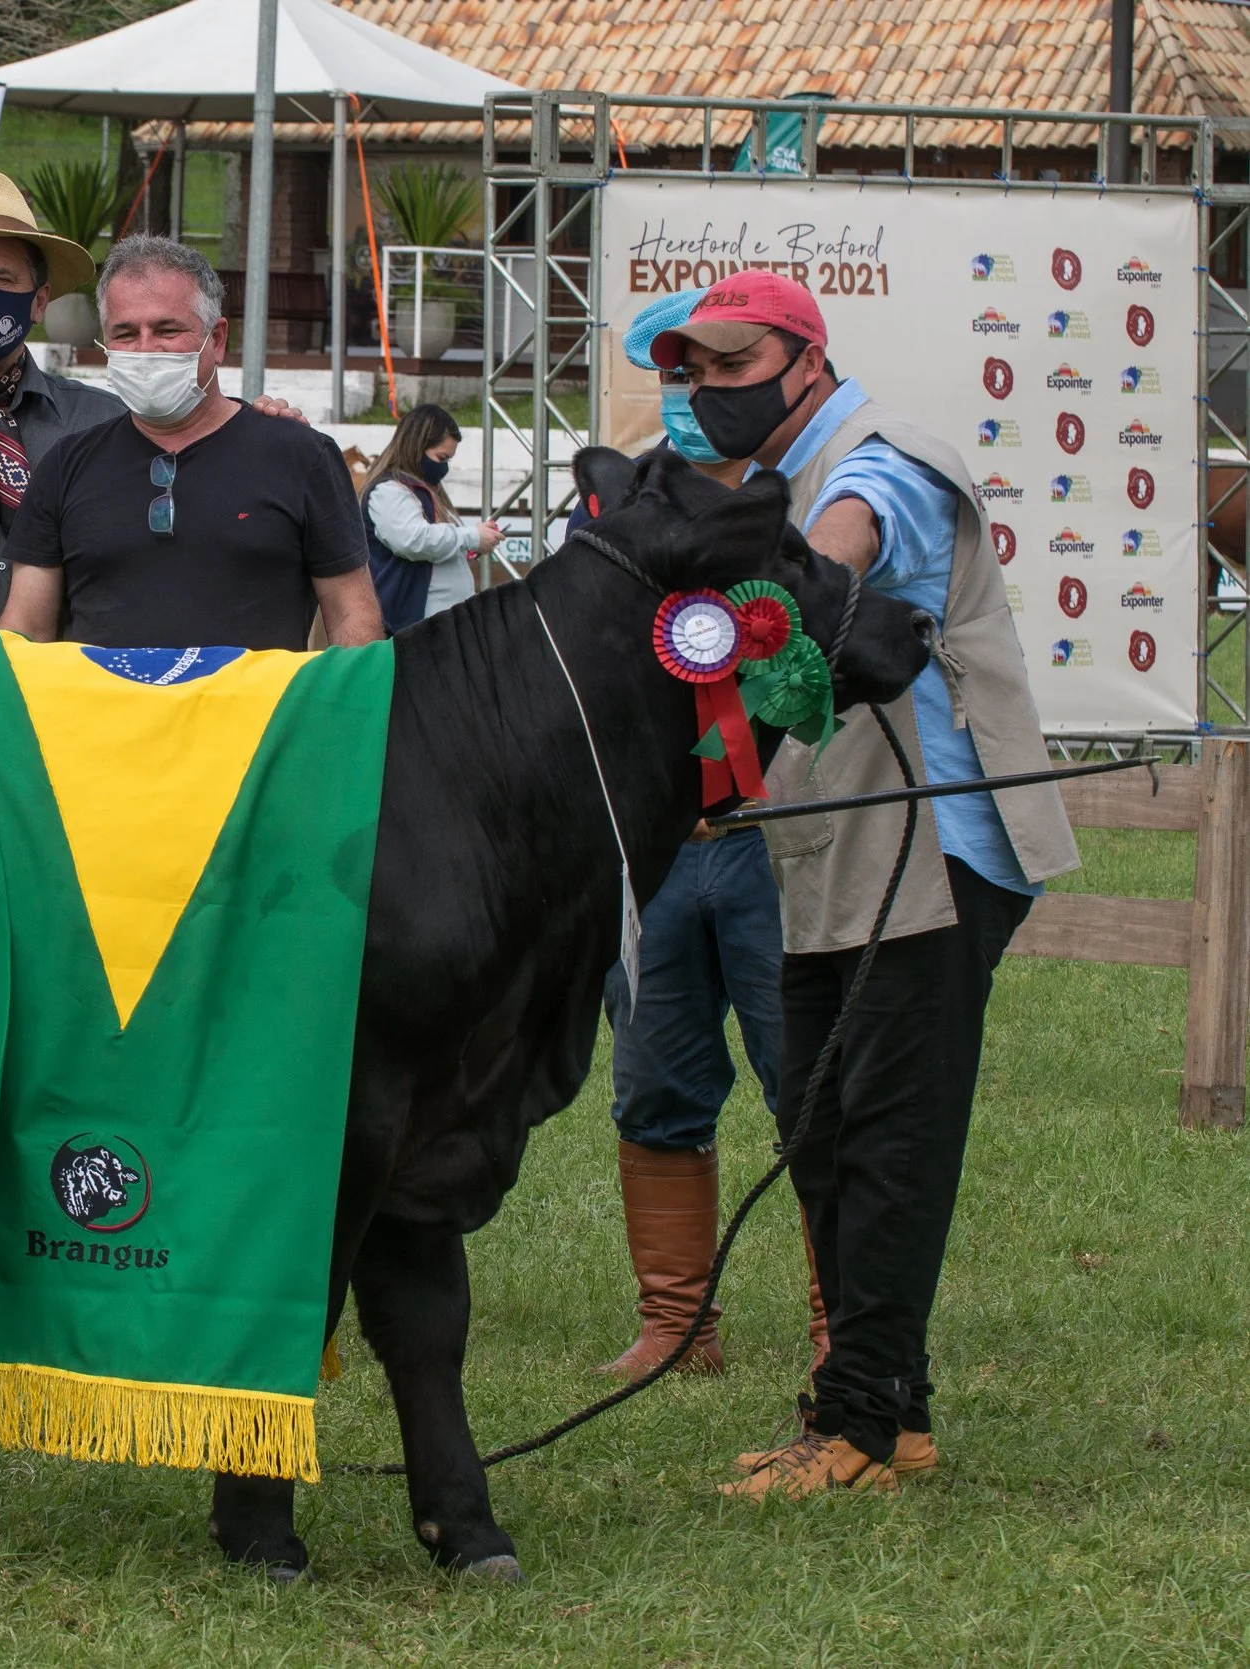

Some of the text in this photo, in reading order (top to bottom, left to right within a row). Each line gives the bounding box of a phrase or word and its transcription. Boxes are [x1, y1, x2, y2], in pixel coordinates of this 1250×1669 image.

[629, 218, 885, 265] Hereford e Braford
[629, 258, 889, 297] EXPOIR 2021
[1116, 268, 1163, 285] Expointer
[972, 319, 1021, 336] Expointer
[1046, 375, 1093, 391] Expointer
[1118, 431, 1163, 447] Expointer
[978, 484, 1025, 501] Expointer
[506, 539, 529, 552] CN
[1049, 540, 1095, 556] Expointer
[1120, 594, 1164, 610] Expointer
[25, 1229, 170, 1271] Brangus
